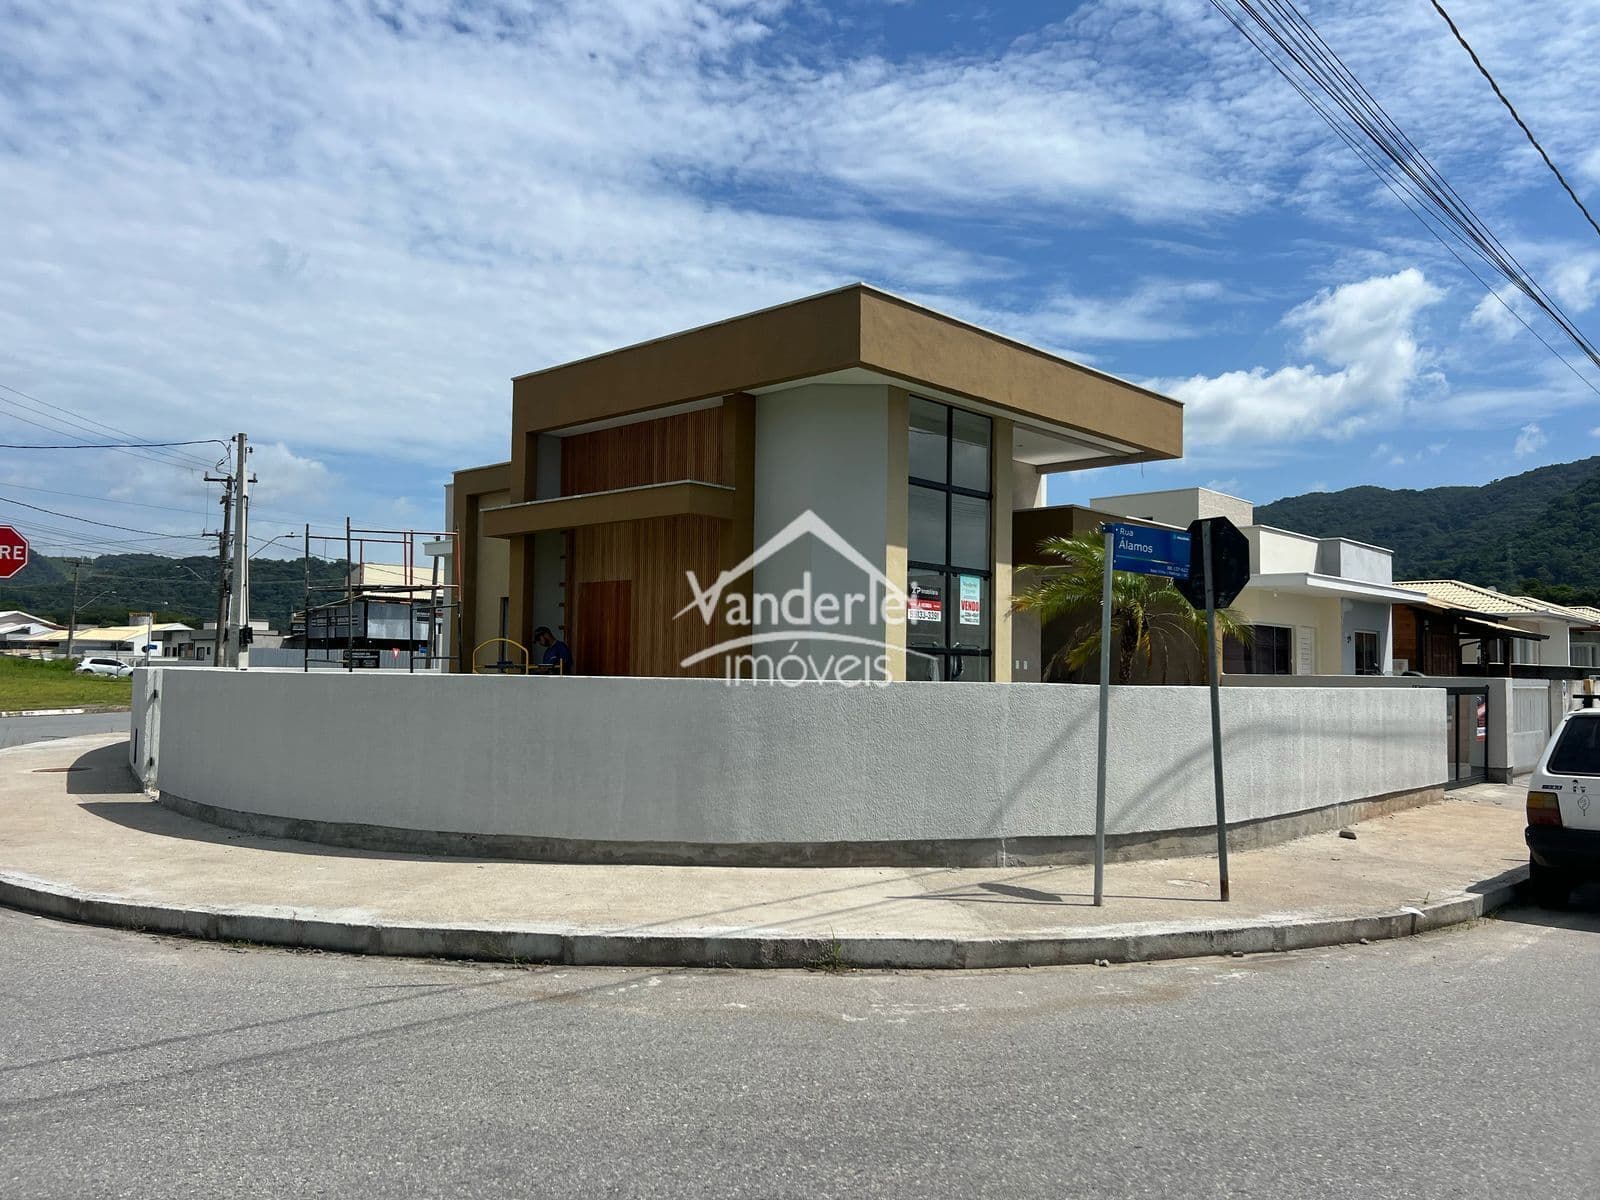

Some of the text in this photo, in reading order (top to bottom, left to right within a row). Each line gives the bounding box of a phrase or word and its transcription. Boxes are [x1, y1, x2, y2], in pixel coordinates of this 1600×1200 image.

[1119, 527, 1134, 537] Rua
[1118, 536, 1153, 553] Álamos
[961, 599, 980, 612] VENDO
